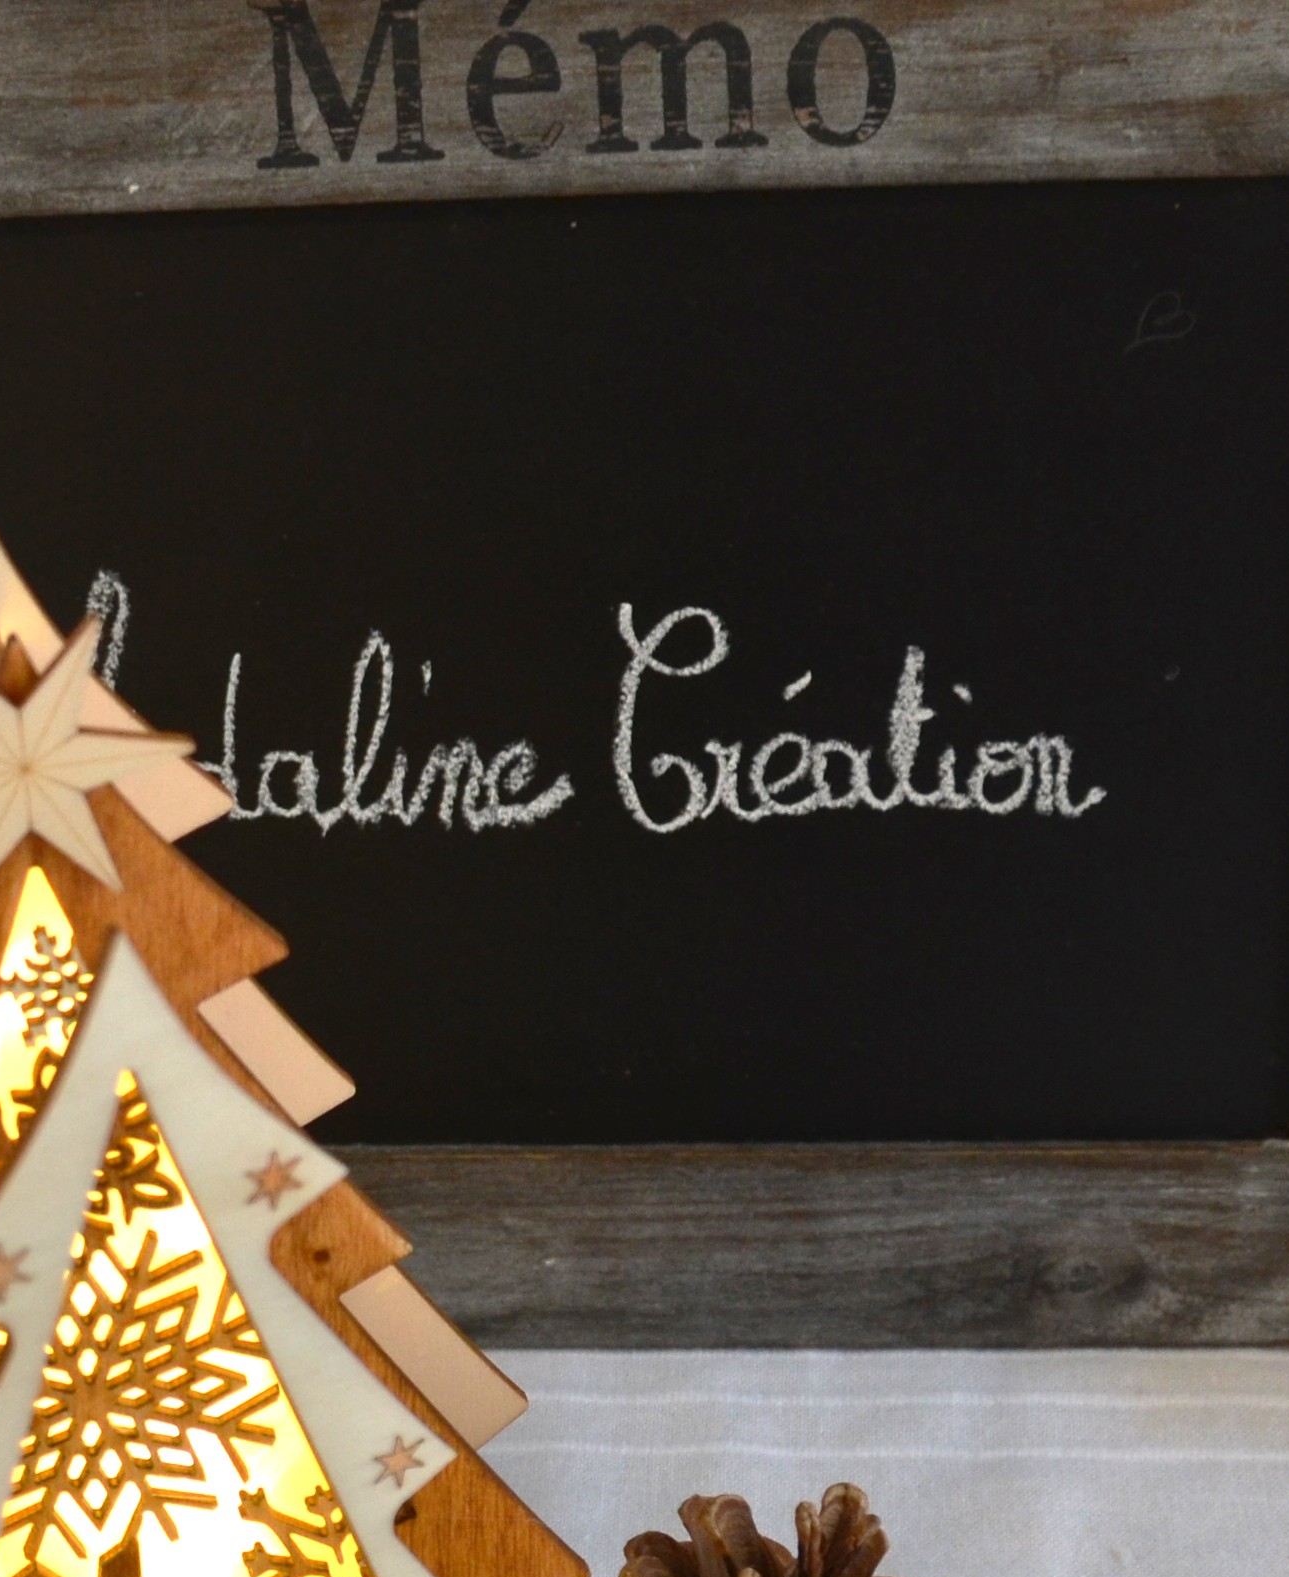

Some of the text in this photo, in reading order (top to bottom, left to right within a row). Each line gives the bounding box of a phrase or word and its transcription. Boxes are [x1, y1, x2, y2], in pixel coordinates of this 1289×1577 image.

[250, 0, 897, 169] Mémo
[85, 568, 1108, 838] daline Création
